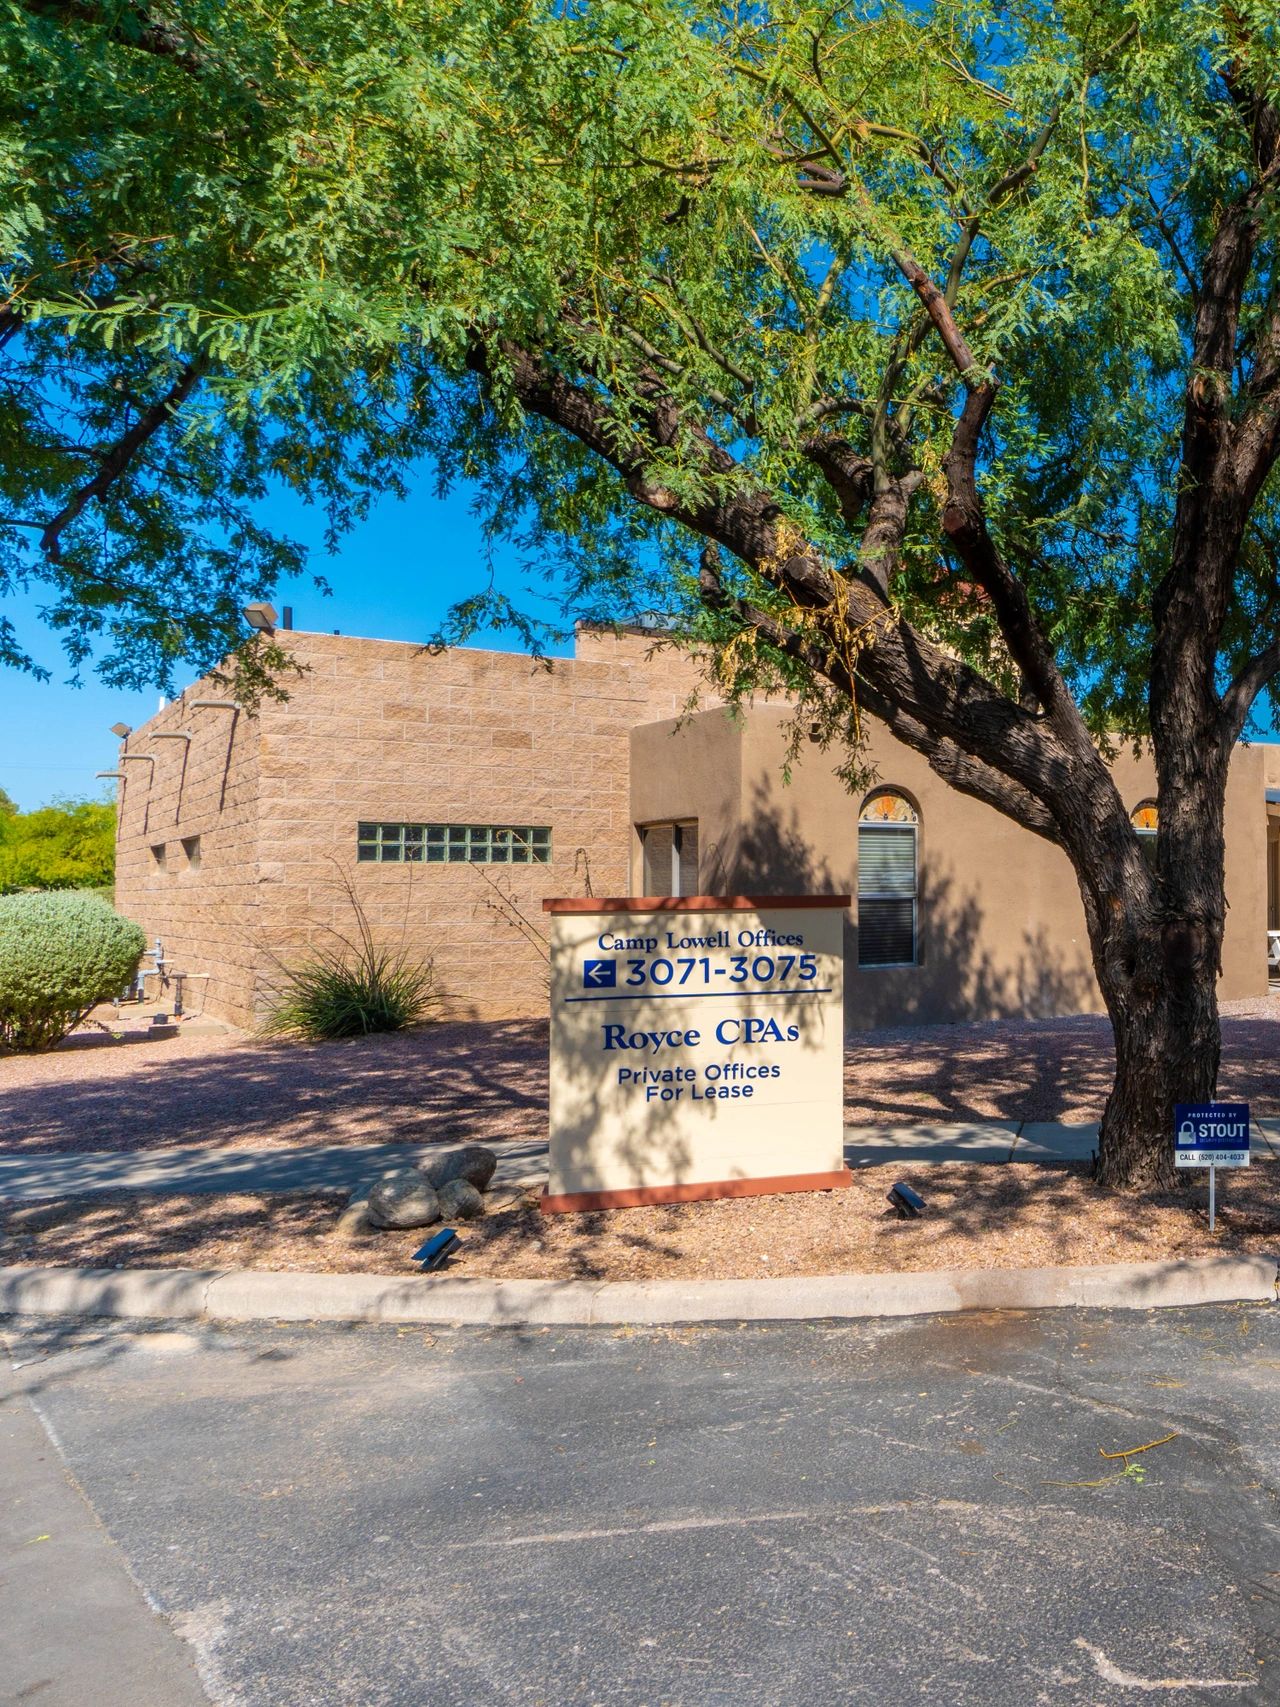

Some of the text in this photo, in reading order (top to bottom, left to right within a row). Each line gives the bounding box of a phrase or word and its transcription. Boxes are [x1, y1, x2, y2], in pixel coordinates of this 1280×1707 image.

[598, 930, 804, 953] Camp Lowell Offices
[625, 954, 817, 986] 3071-3075
[601, 1017, 800, 1055] Royce CPAs
[618, 1063, 780, 1084] Private Offices
[646, 1084, 754, 1102] For Lease
[1199, 1123, 1246, 1138] STOUT
[1179, 1153, 1196, 1161] CALL
[1198, 1153, 1215, 1162] (520)
